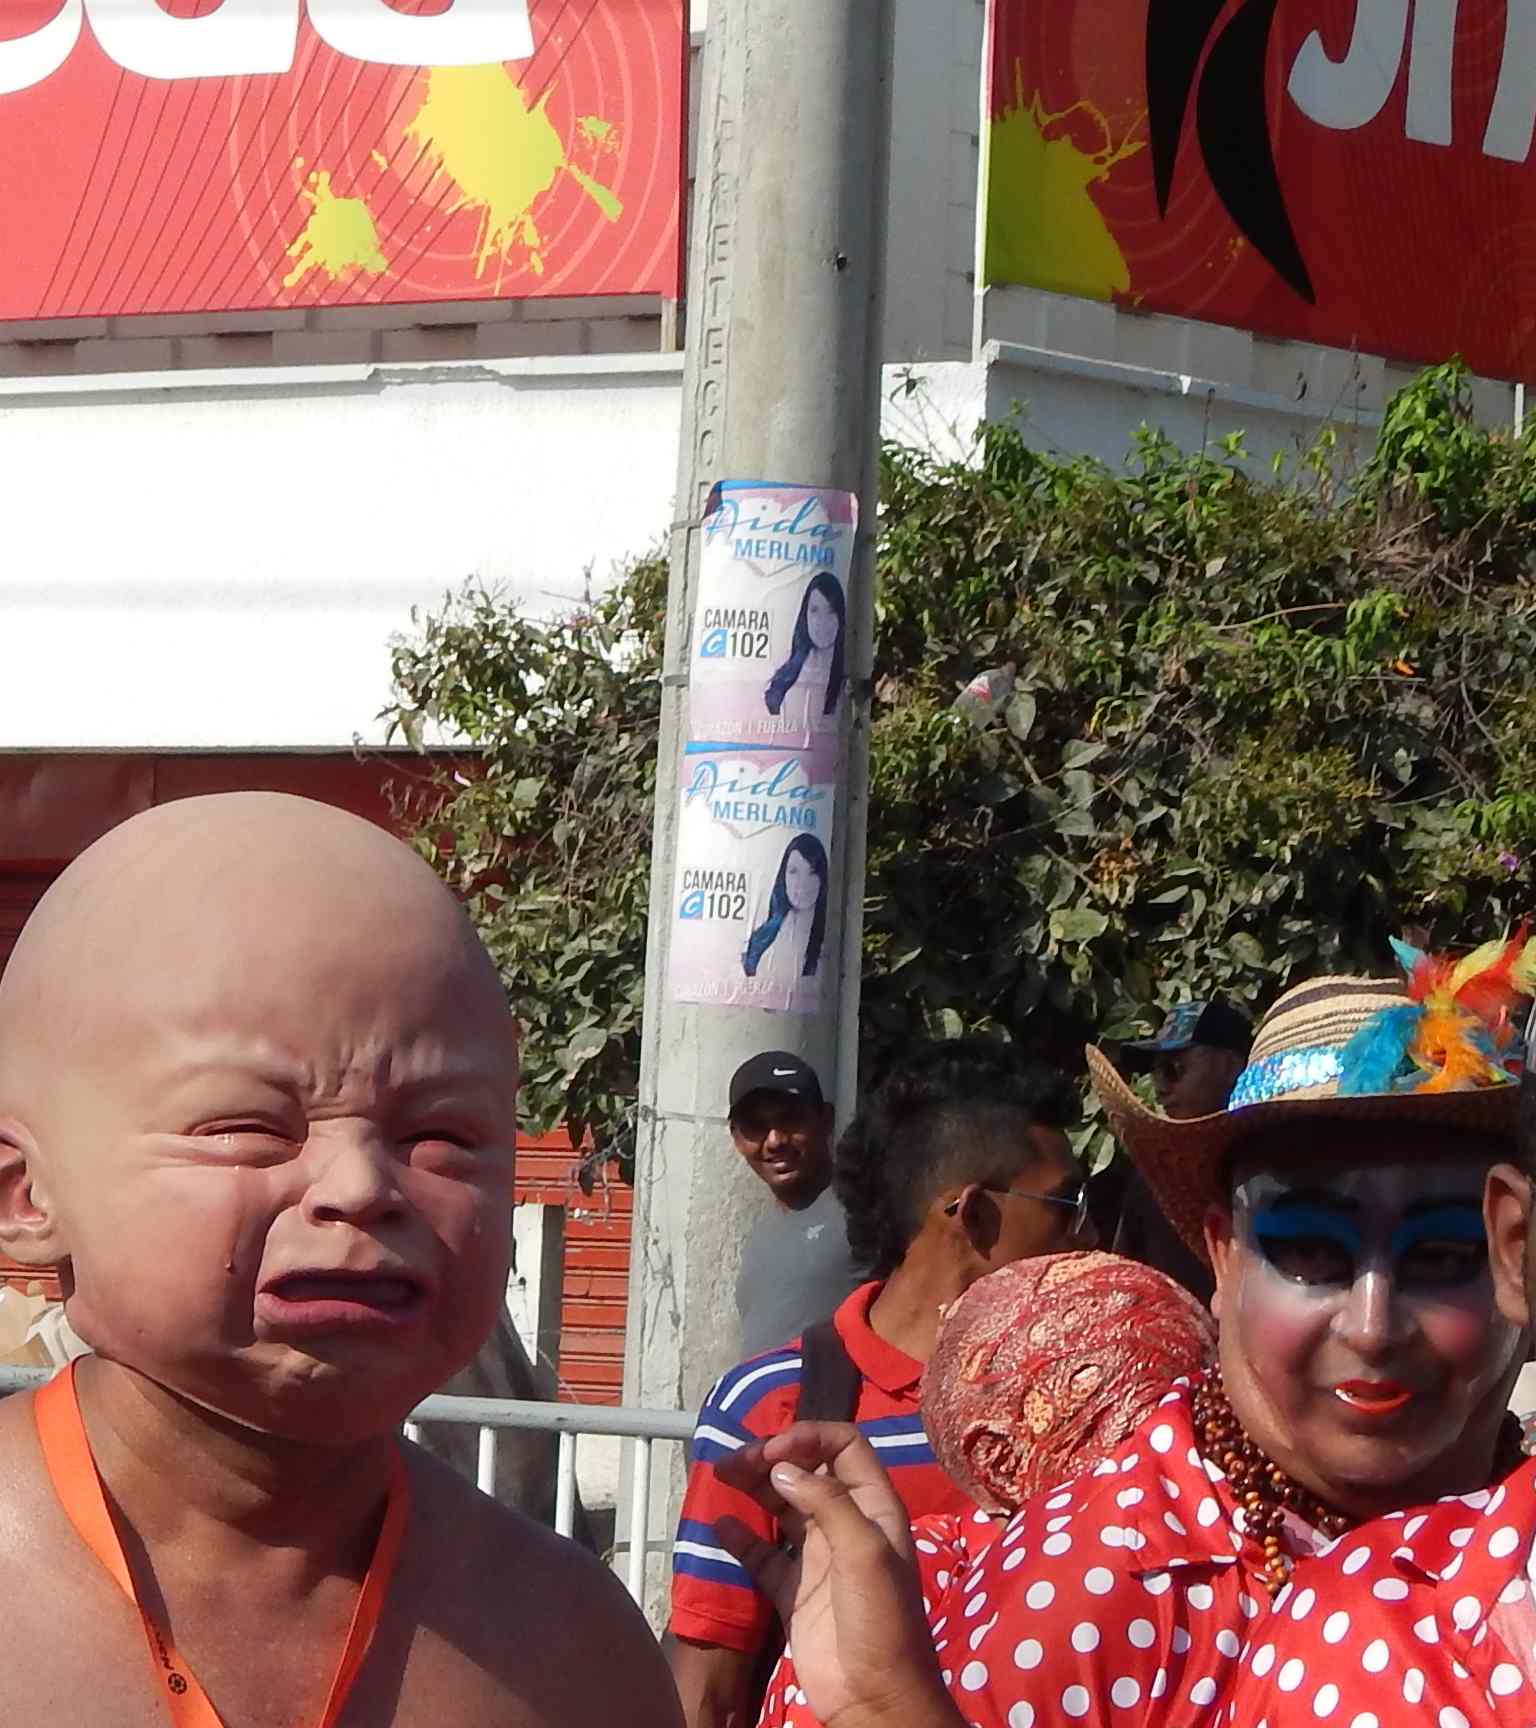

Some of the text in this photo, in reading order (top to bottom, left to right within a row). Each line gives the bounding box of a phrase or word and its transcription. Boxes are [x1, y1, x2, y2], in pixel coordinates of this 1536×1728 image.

[704, 496, 842, 545] Aida
[734, 539, 834, 566] MERLANO
[704, 608, 769, 630] CAMARA
[731, 632, 769, 658] 102
[684, 760, 825, 804] Aida
[713, 801, 817, 828] MERLANO
[683, 870, 747, 892] CAMARA
[708, 894, 746, 920] 102
